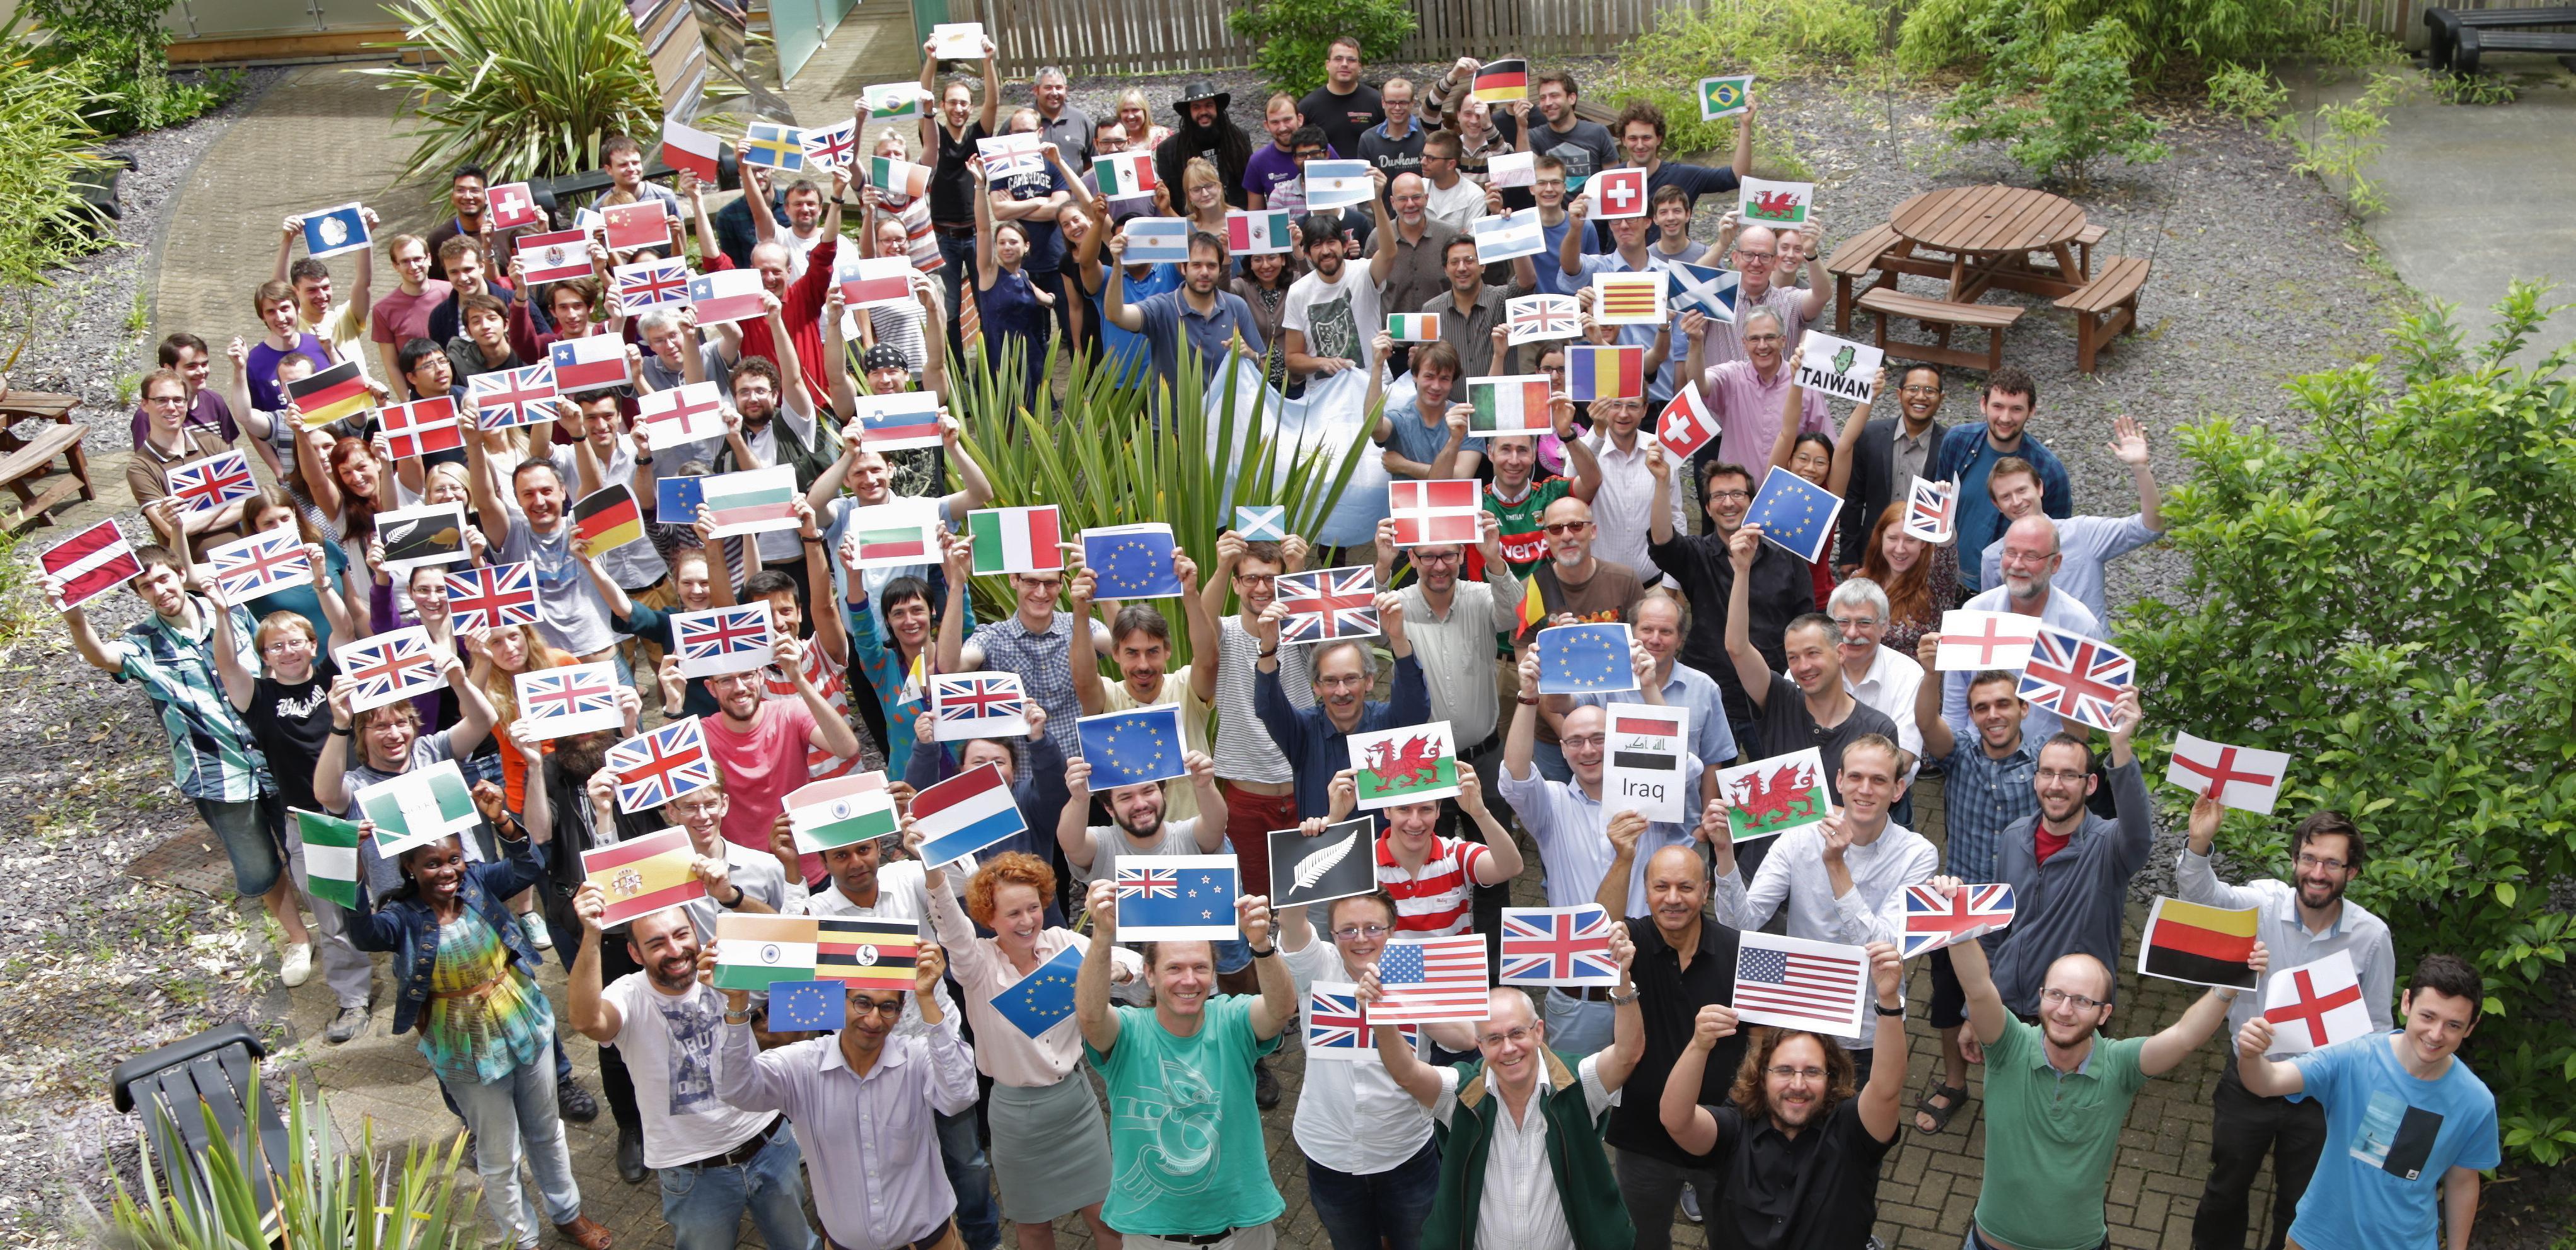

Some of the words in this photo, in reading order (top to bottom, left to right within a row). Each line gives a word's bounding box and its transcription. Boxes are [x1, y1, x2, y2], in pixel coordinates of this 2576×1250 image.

[1379, 152, 1420, 168] Durham
[1802, 366, 1871, 399] TAIWAN
[1623, 777, 1664, 803] Iraq
